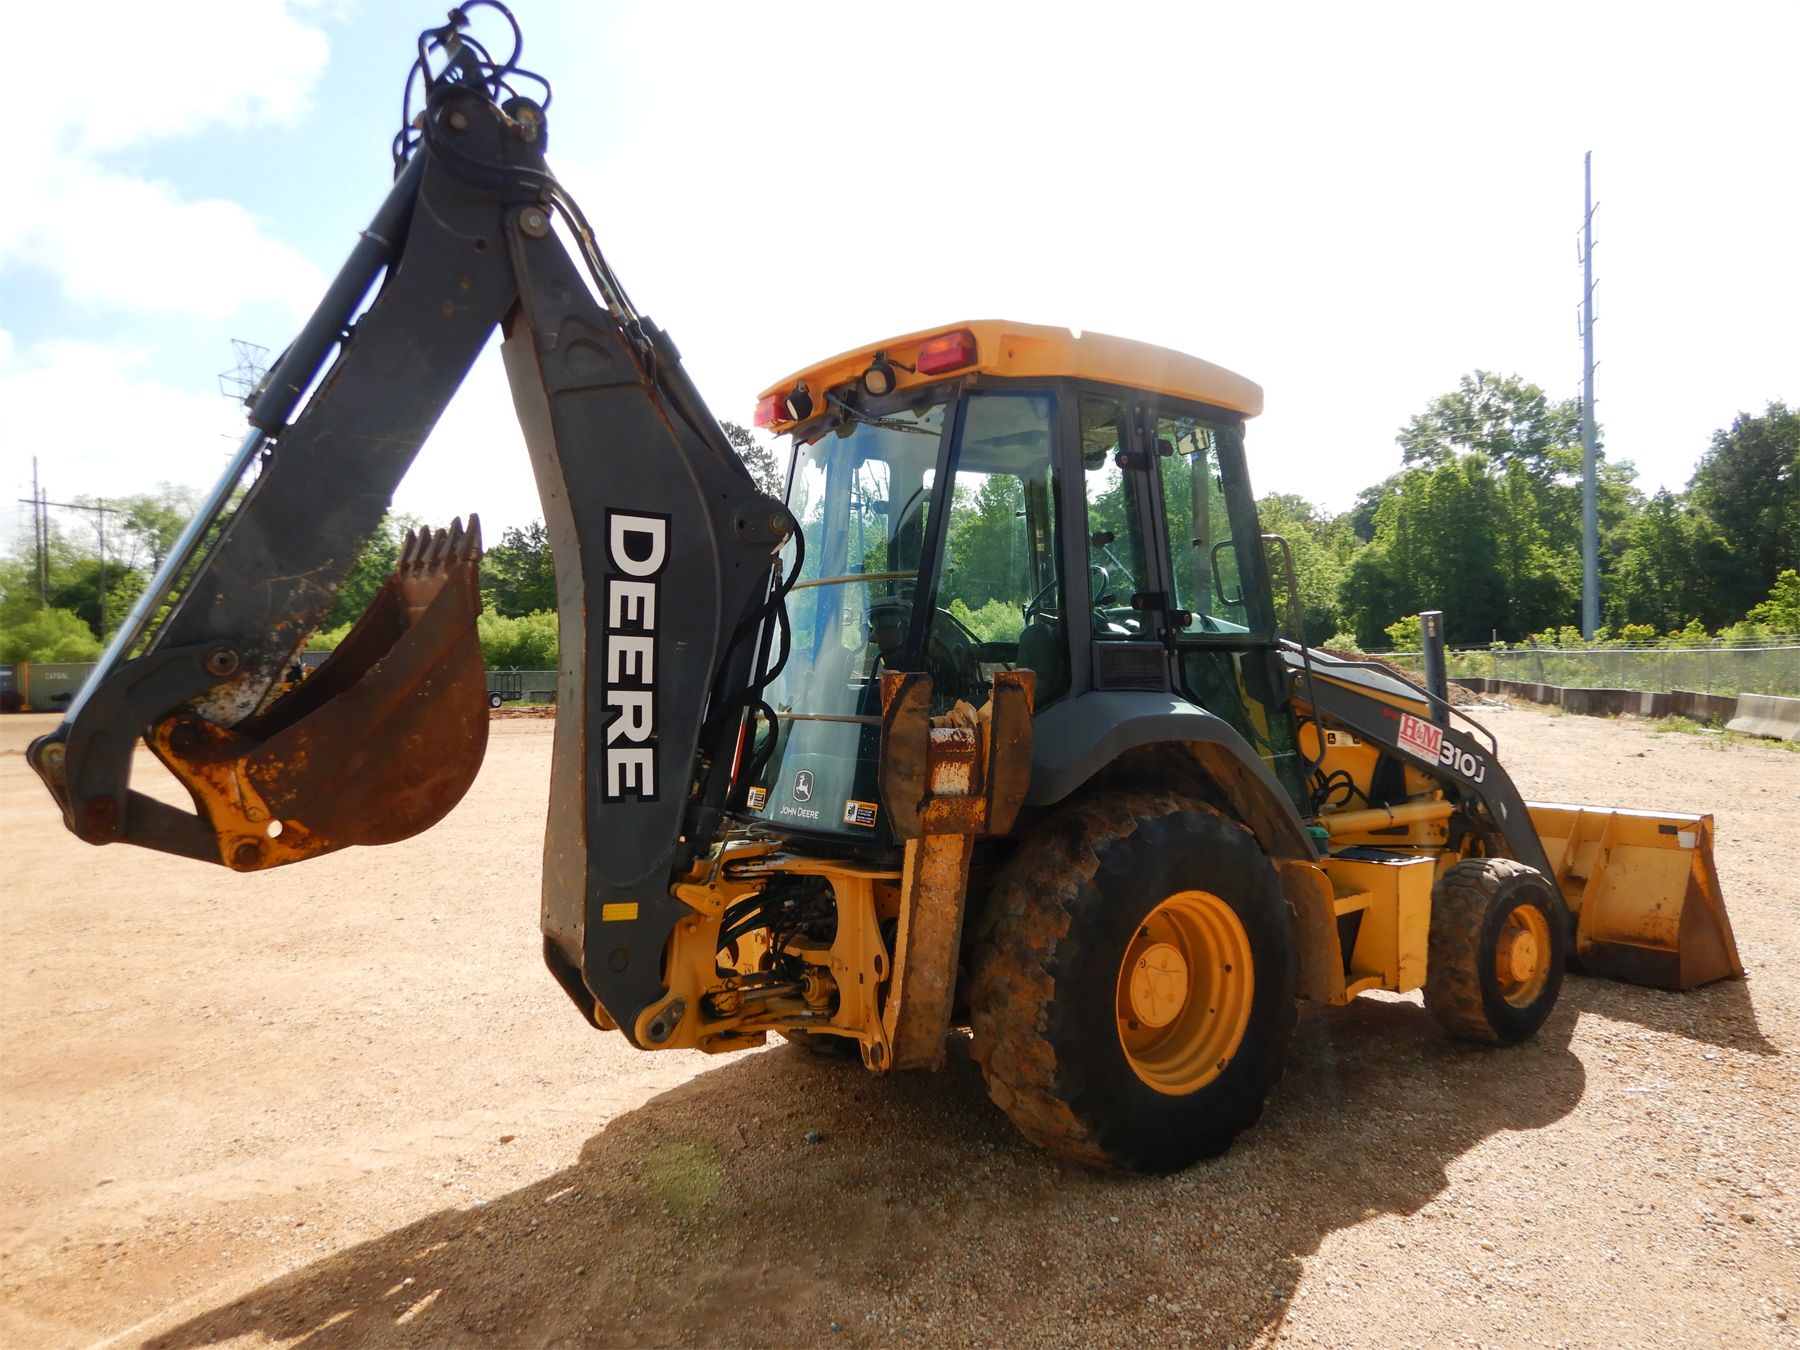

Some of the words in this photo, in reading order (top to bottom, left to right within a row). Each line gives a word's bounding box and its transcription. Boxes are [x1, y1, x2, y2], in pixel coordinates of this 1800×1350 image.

[607, 514, 666, 797] DEERE
[1401, 714, 1442, 750] H&M
[1440, 740, 1486, 783] 310J
[780, 805, 797, 815] JOHN
[797, 806, 820, 819] DEERE
